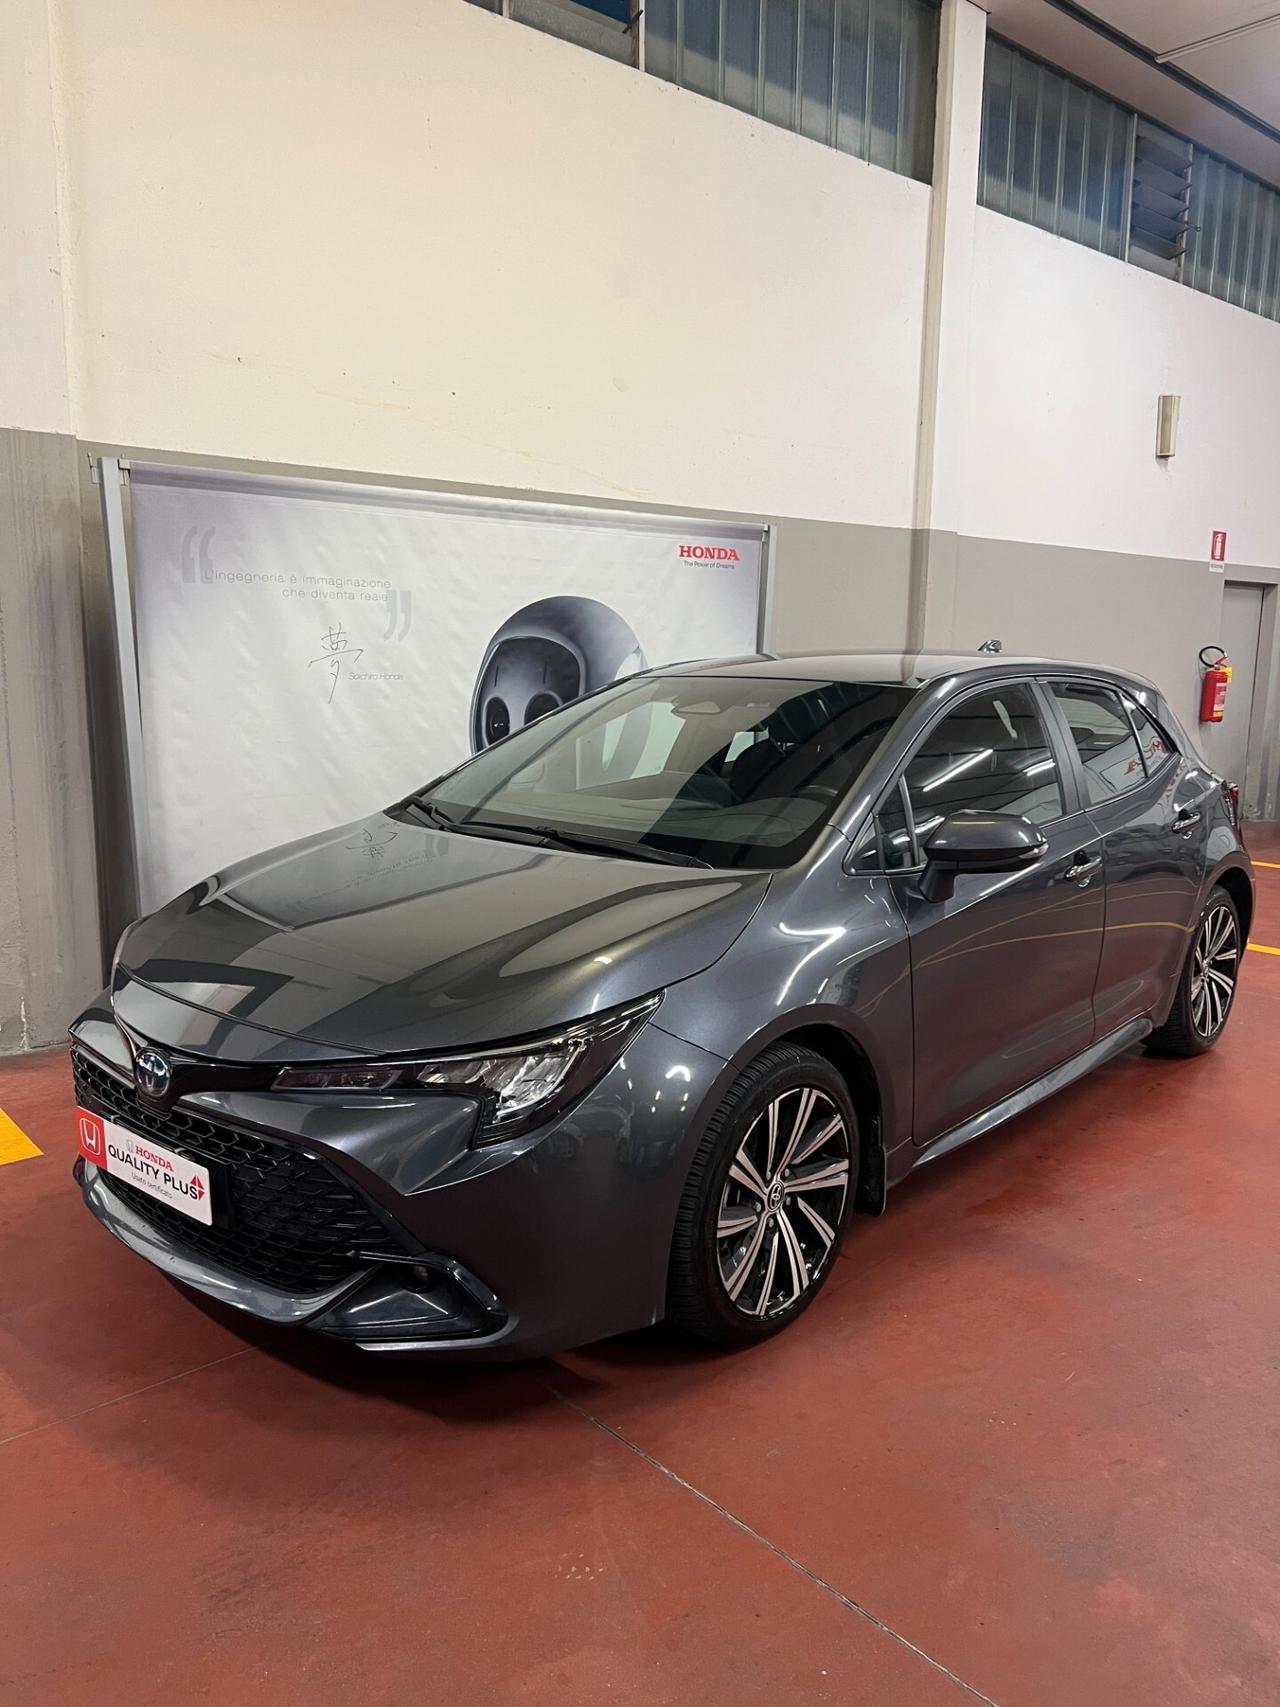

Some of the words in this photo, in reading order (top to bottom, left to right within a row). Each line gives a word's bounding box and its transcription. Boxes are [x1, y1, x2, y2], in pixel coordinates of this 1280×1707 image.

[679, 545, 740, 561] HONDA
[684, 560, 694, 568] The
[716, 562, 735, 570] Dreams
[302, 575, 391, 589] immaginazione
[282, 588, 306, 599] che
[311, 589, 355, 601] diventa
[360, 591, 389, 602] reale
[380, 671, 404, 681] Honda
[135, 1145, 174, 1172] HONDA
[108, 1144, 160, 1180] QUALITY
[163, 1172, 198, 1200] PLUS
